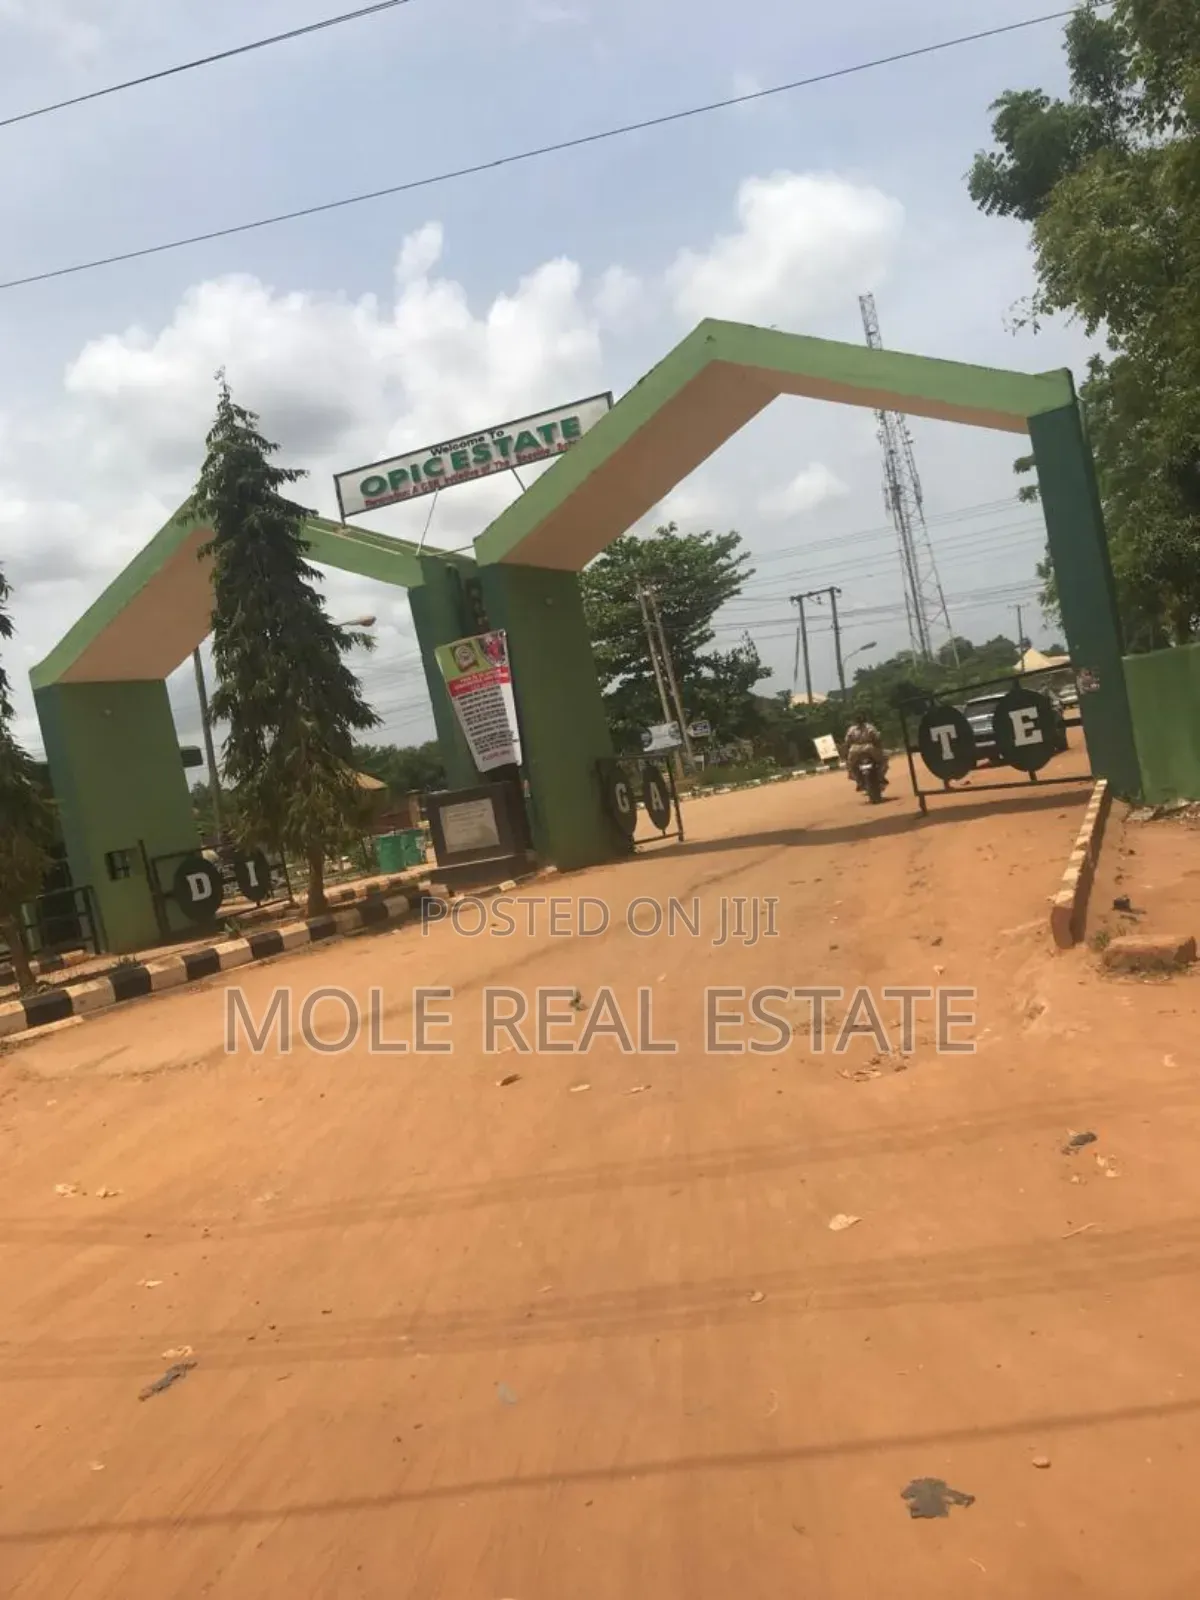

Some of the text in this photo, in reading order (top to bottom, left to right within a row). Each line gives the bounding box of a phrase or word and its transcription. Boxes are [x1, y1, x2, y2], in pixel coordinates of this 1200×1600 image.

[360, 415, 581, 497] OPIC ESTATE
[430, 430, 504, 456] Welcome To
[929, 706, 1043, 760] T E
[614, 781, 664, 813] G A
[186, 860, 259, 902] D I
